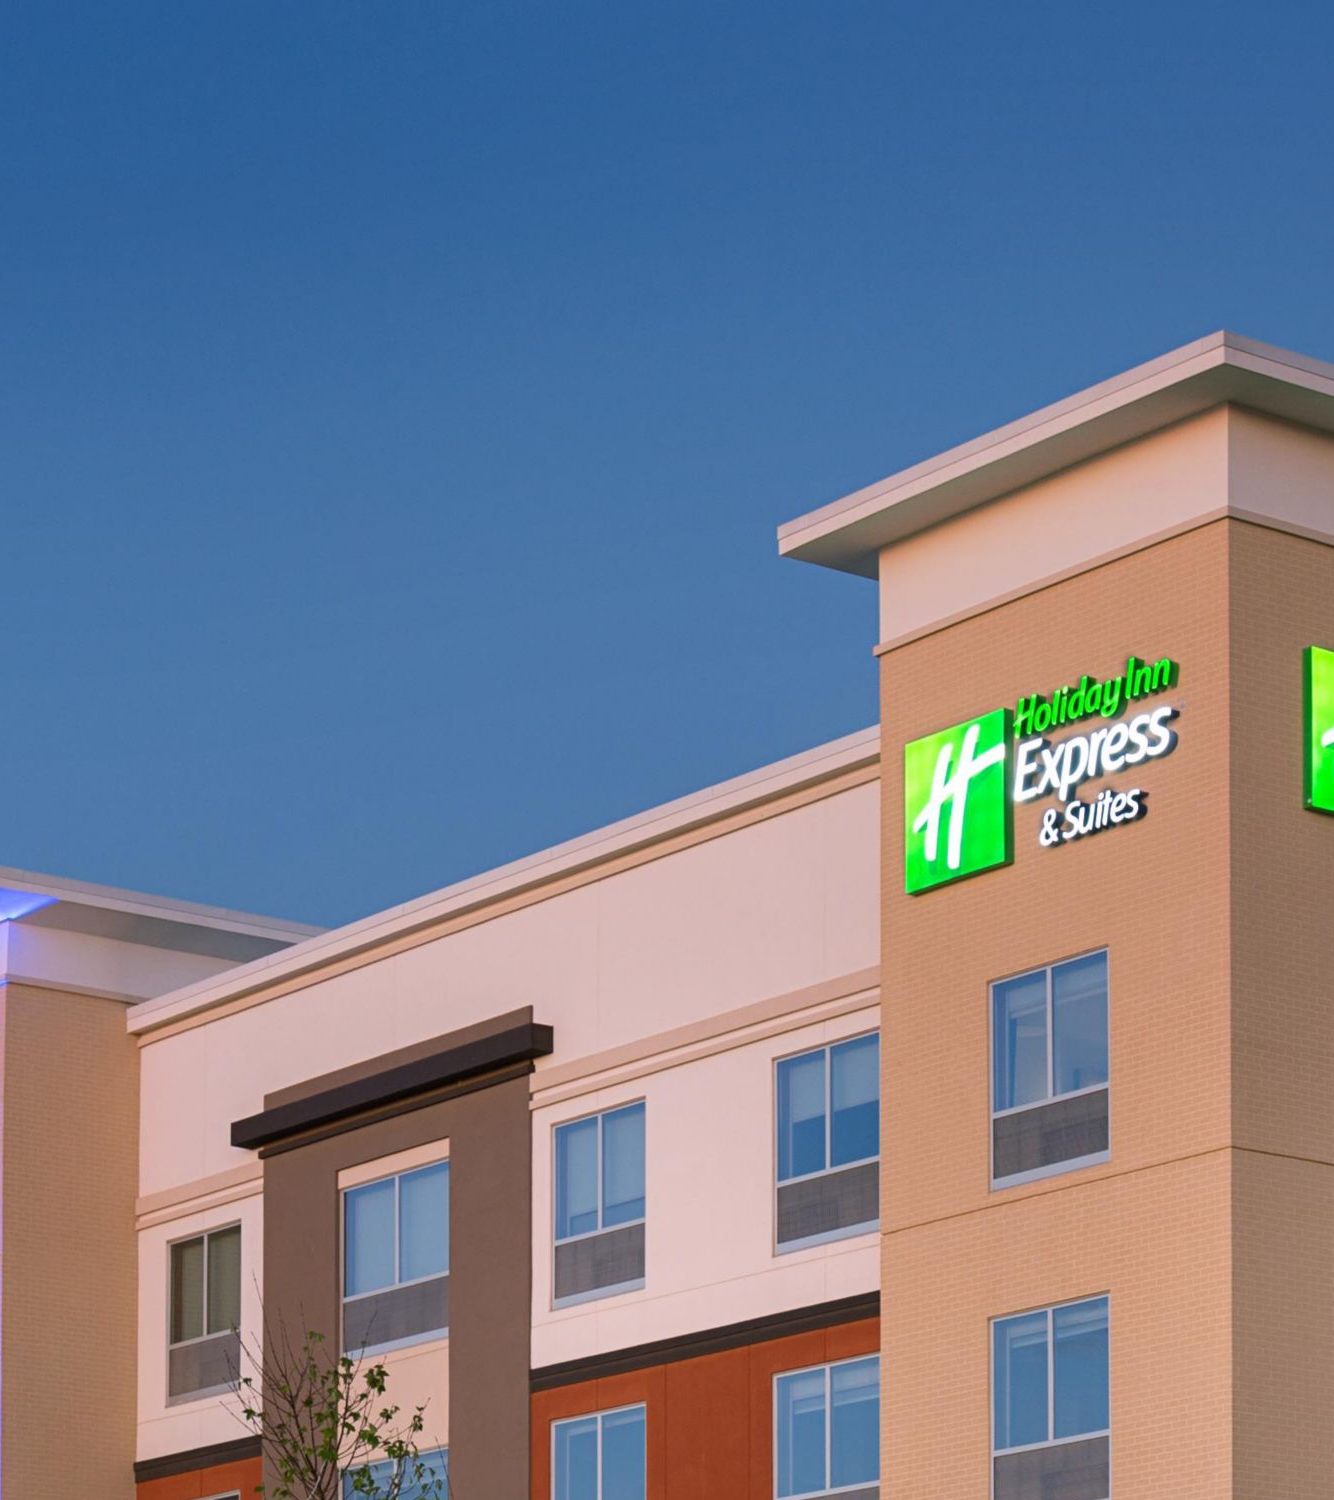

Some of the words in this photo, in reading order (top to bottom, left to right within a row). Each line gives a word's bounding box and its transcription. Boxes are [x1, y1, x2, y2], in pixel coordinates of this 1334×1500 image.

[1013, 675, 1122, 739] Holiday
[1125, 656, 1171, 699] Inn
[1013, 706, 1172, 802] Express
[1039, 808, 1059, 847] &
[1062, 788, 1141, 840] Suites
